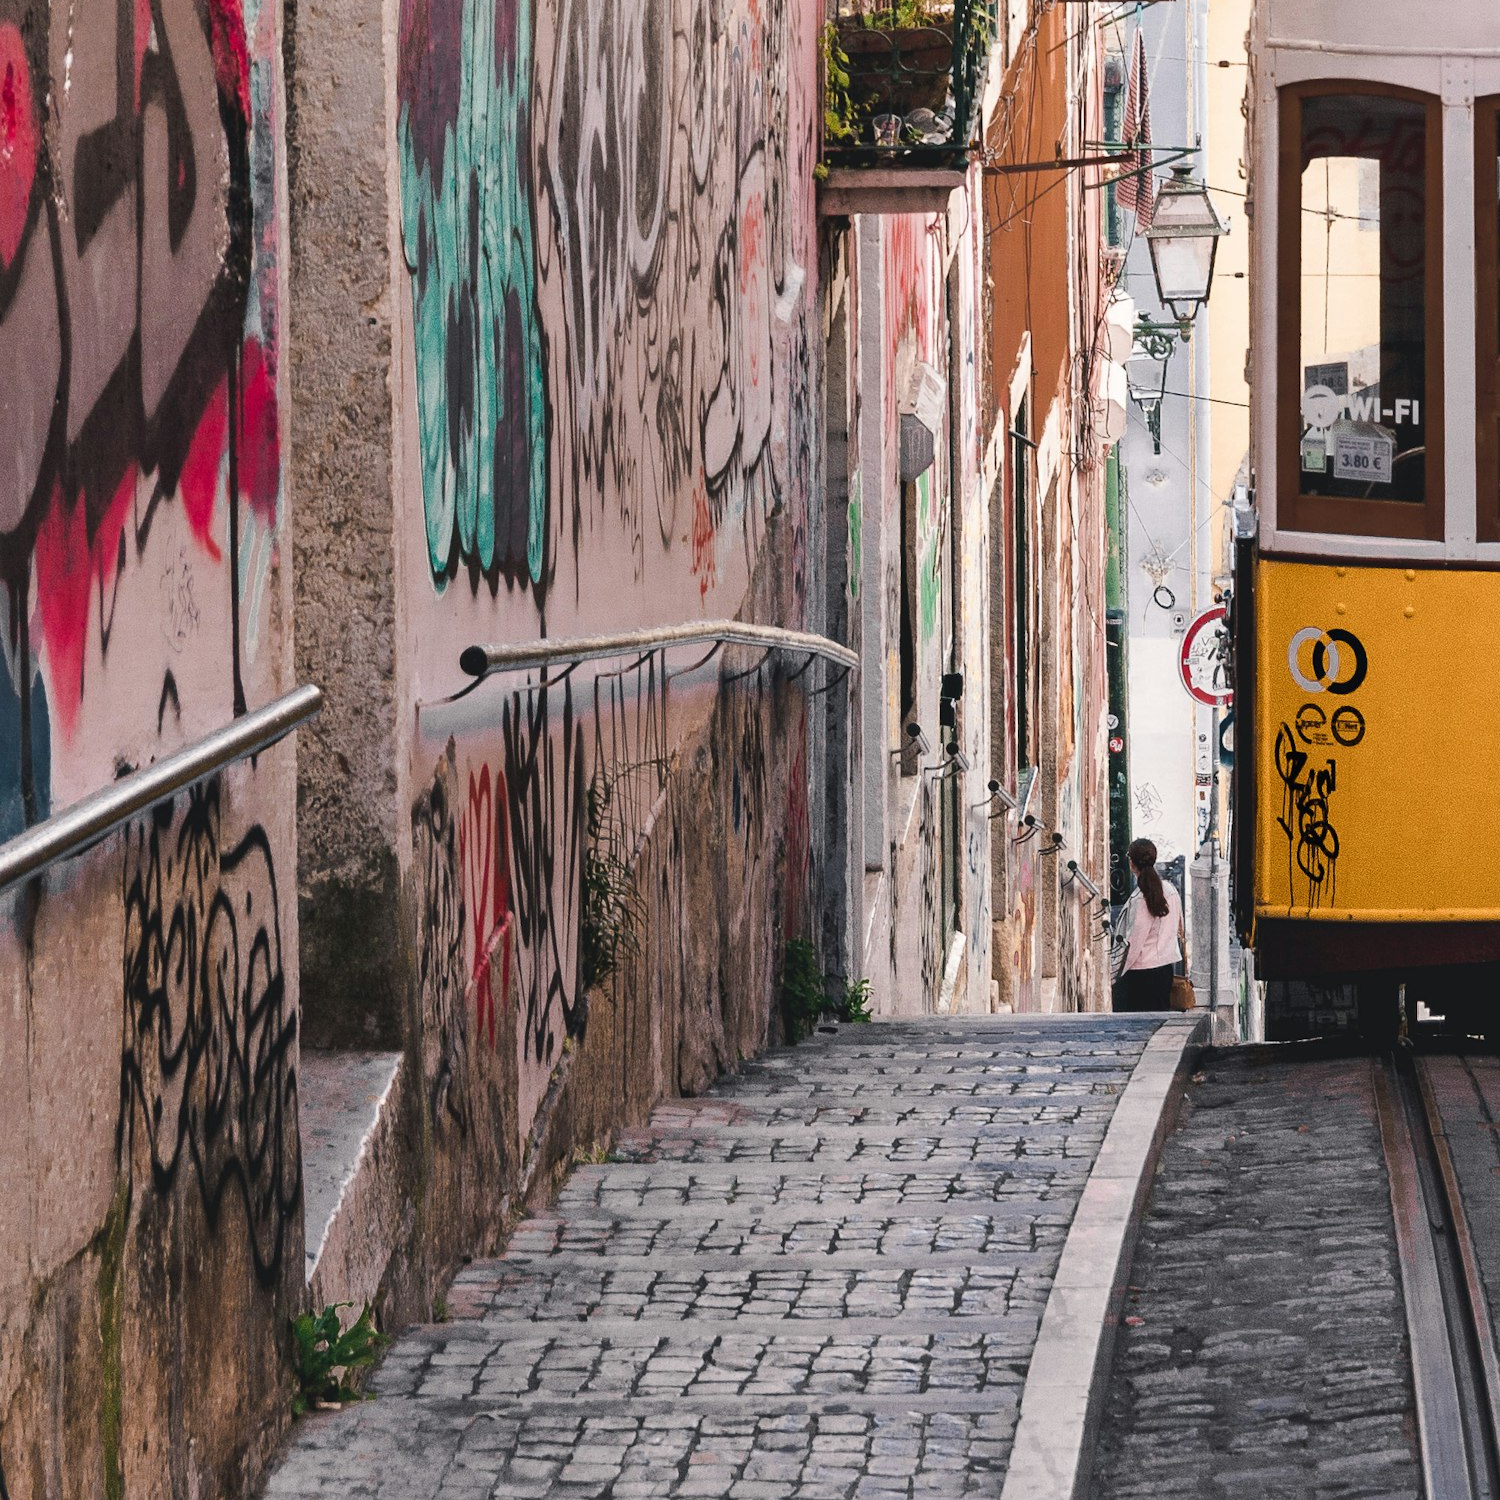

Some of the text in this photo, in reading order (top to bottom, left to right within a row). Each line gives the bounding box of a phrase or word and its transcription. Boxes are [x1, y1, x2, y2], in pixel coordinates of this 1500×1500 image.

[1346, 394, 1419, 425] WI-FI
[1342, 454, 1381, 470] 3.80 €
